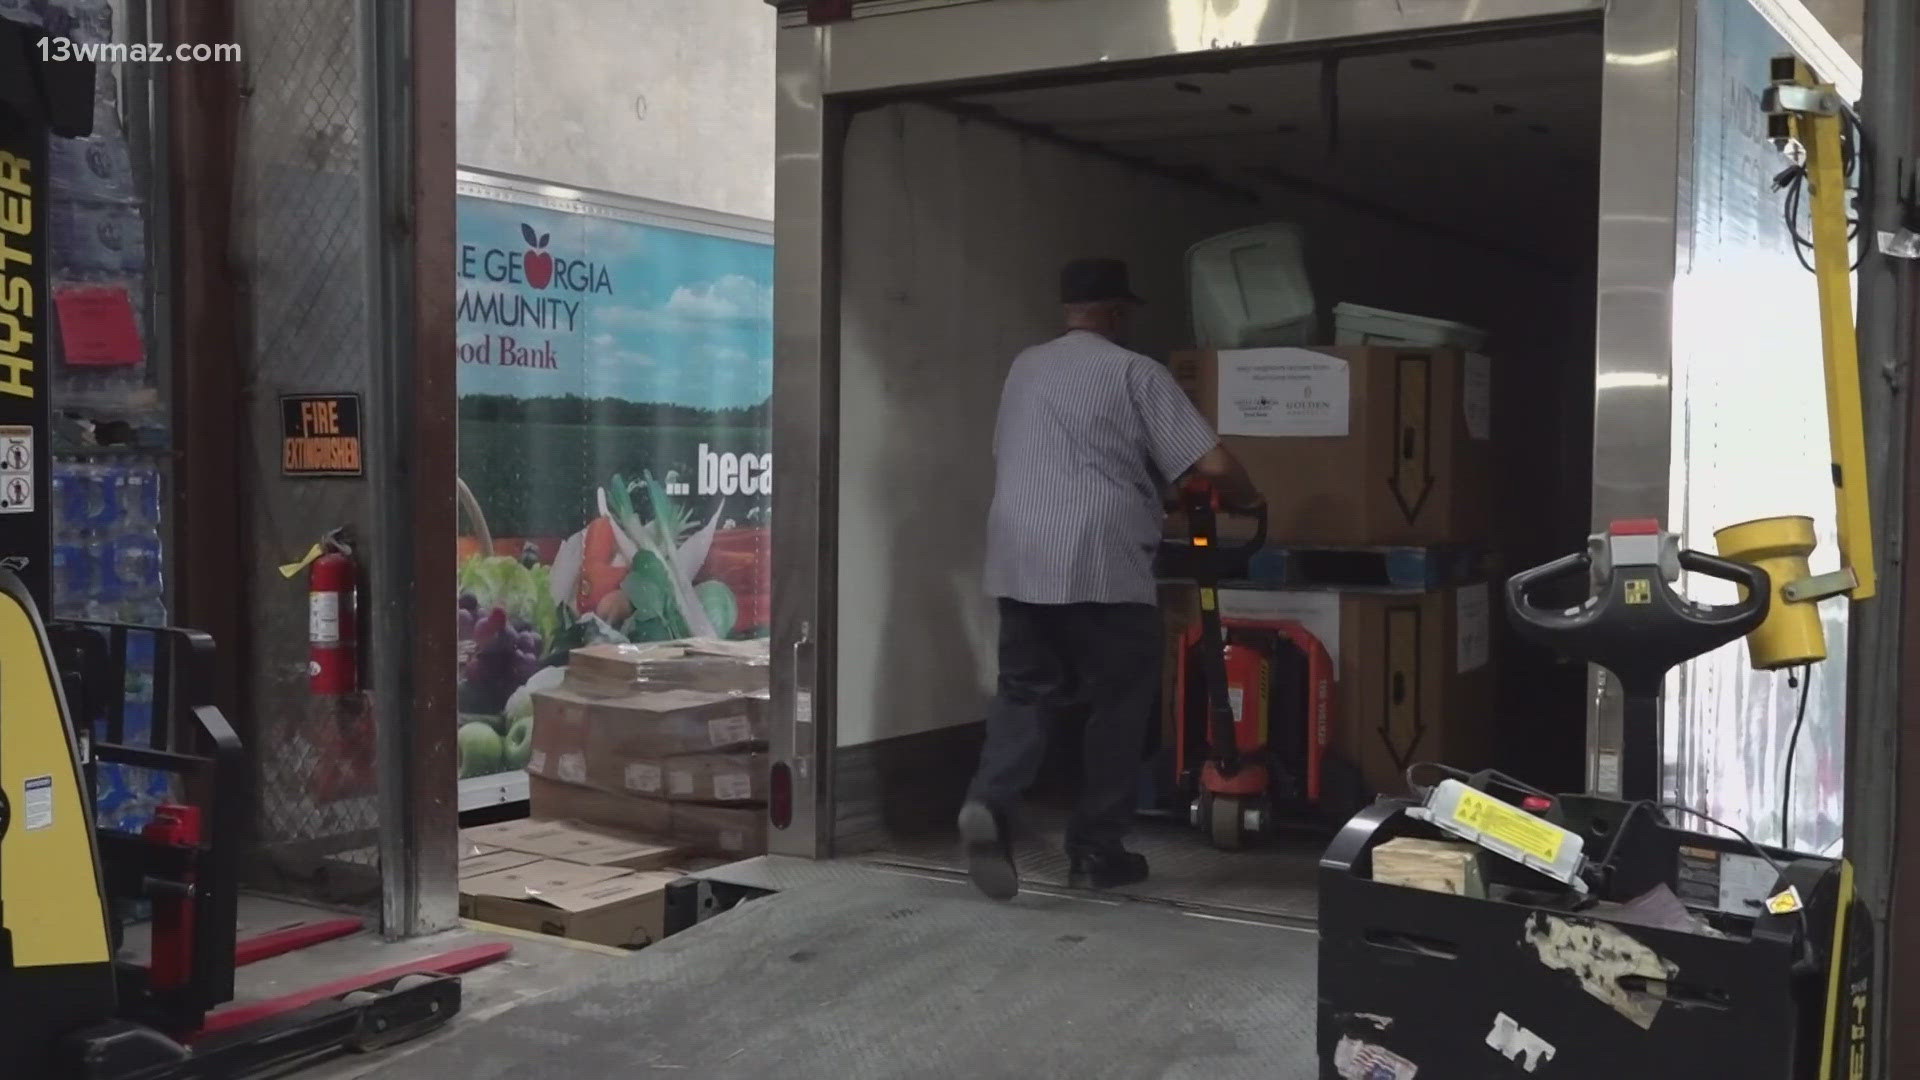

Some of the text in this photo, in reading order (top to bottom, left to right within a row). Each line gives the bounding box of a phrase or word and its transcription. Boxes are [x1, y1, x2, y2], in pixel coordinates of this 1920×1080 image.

[0, 151, 34, 399] HYSTER
[457, 245, 476, 278] E
[457, 335, 559, 370] od Bank
[301, 401, 340, 436] FIRE
[698, 443, 773, 495] beca
